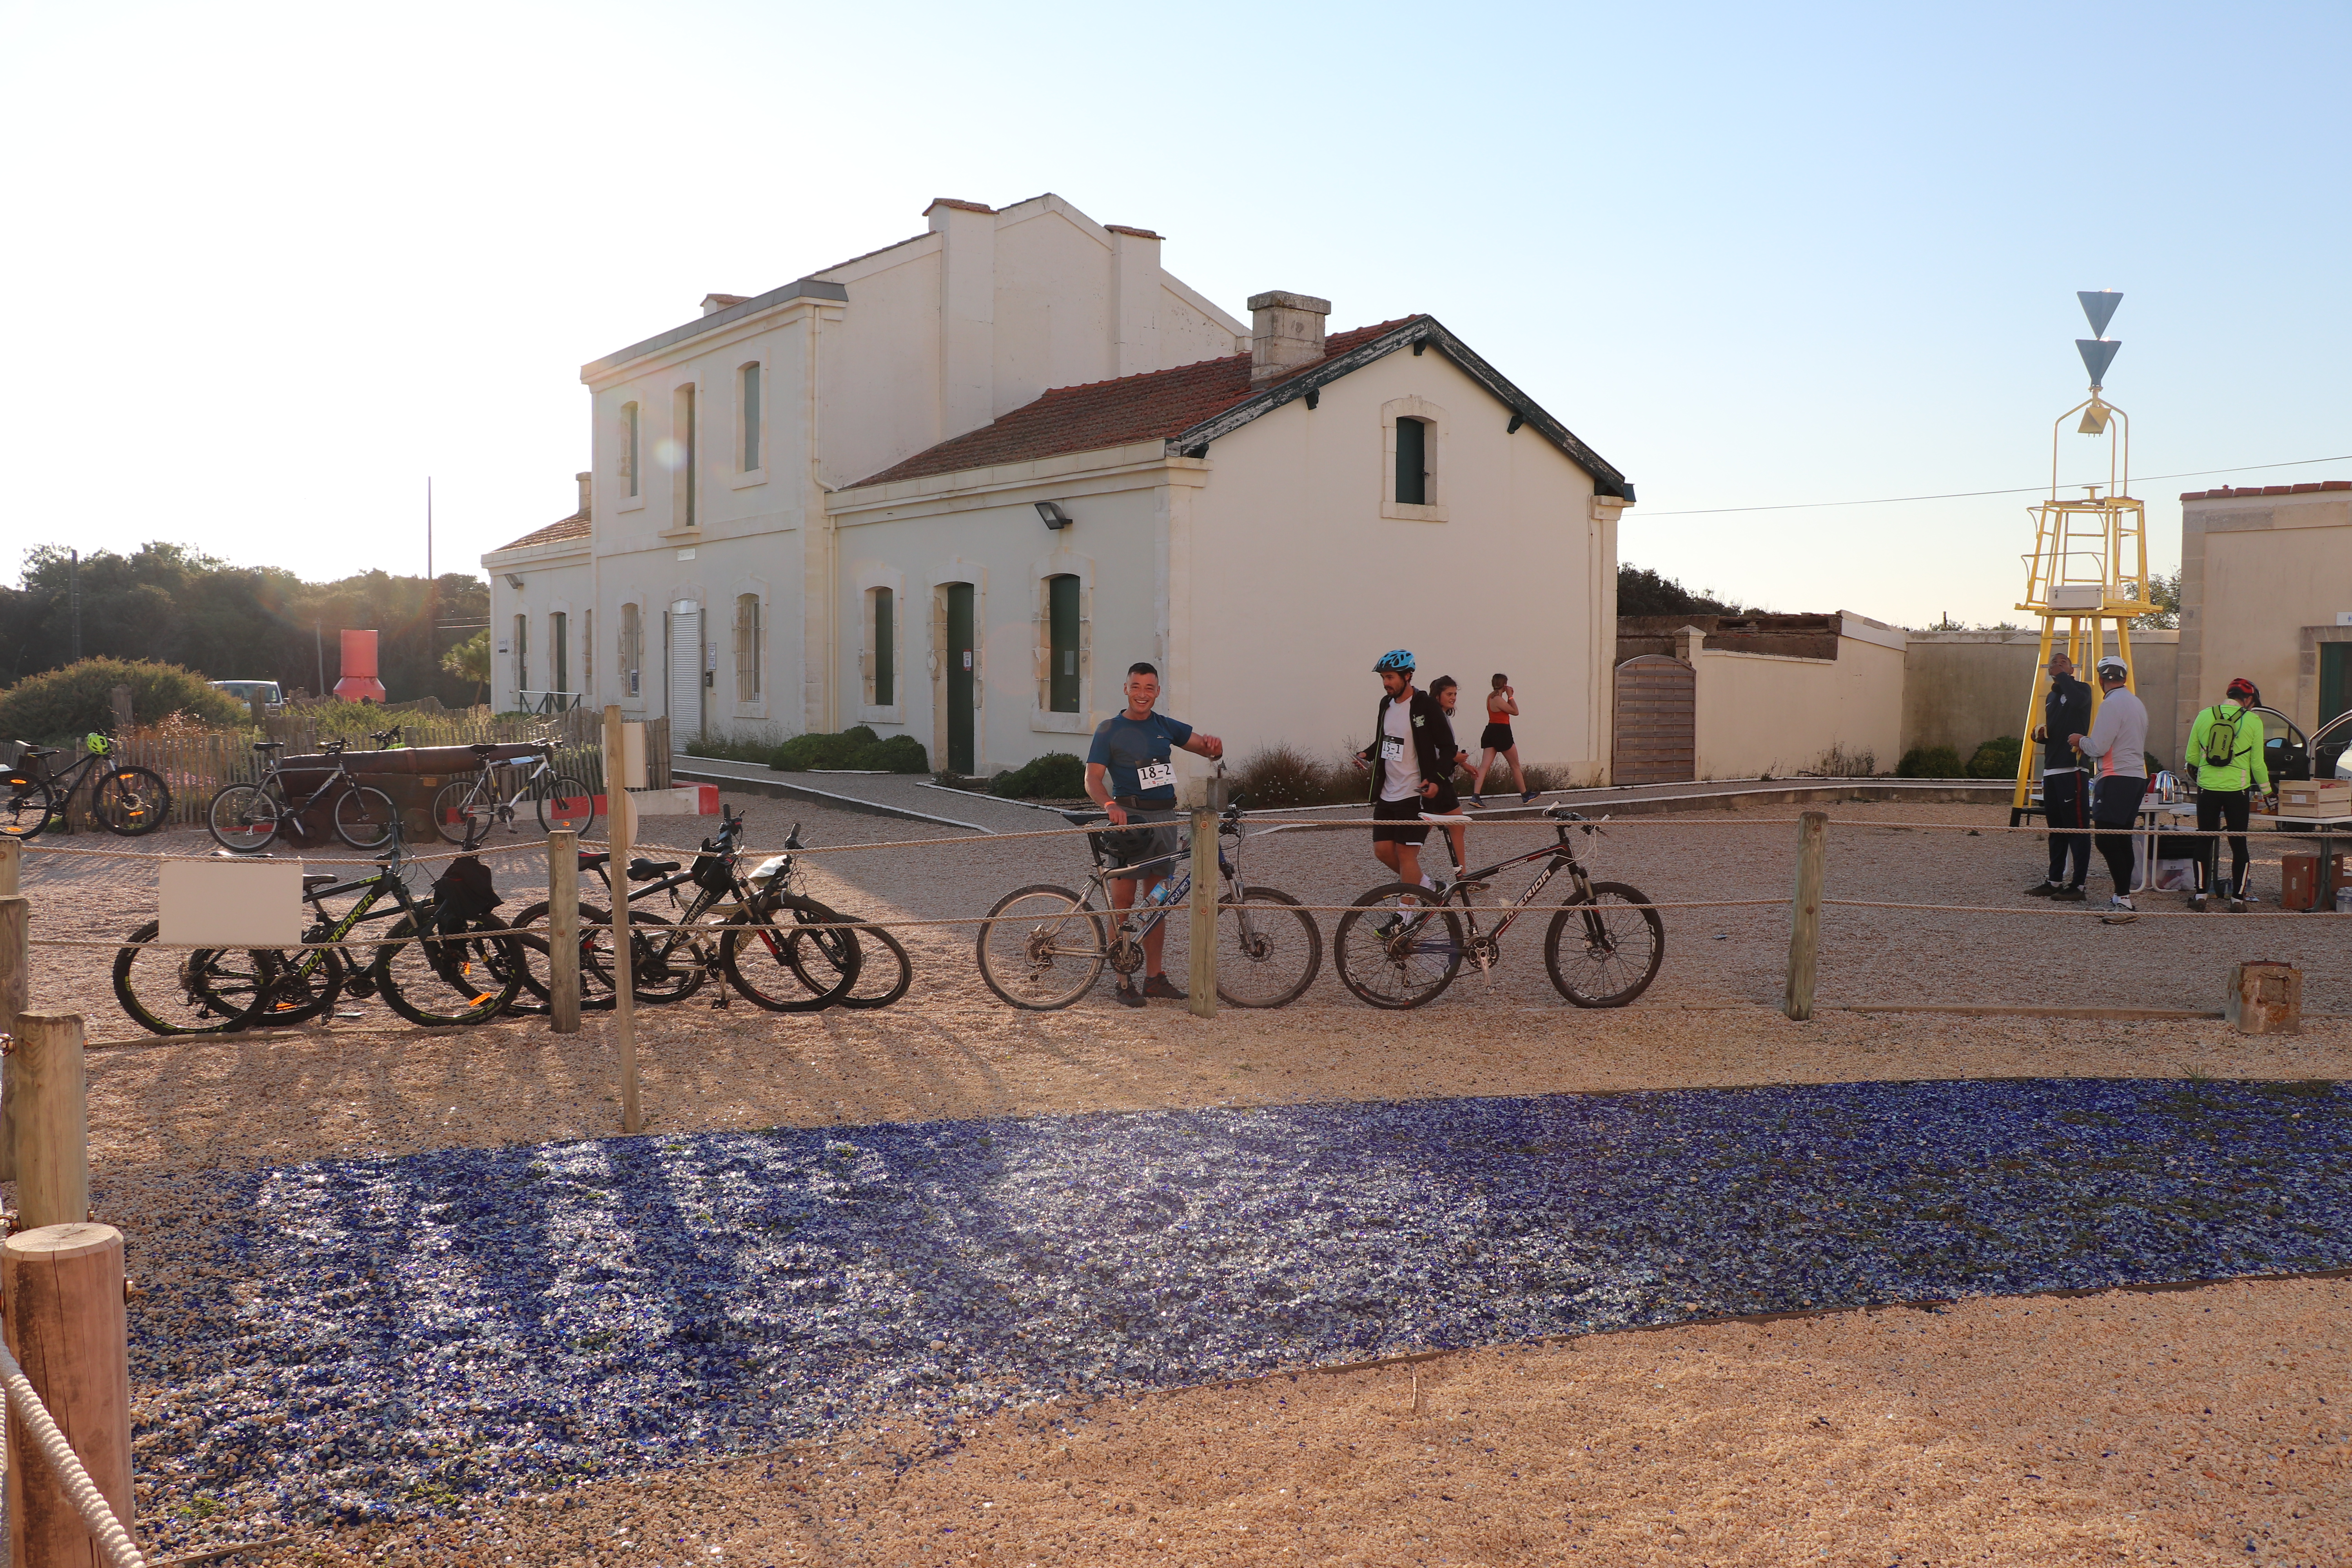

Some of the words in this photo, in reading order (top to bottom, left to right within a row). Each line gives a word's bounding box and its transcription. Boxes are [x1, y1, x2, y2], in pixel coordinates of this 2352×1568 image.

[1383, 742, 1400, 754] 15-1
[1140, 764, 1171, 780] 18-2
[1498, 858, 1528, 872] CARBON
[1344, 967, 1356, 986] COBRA
[1370, 996, 1404, 1005] HUTCHINSON
